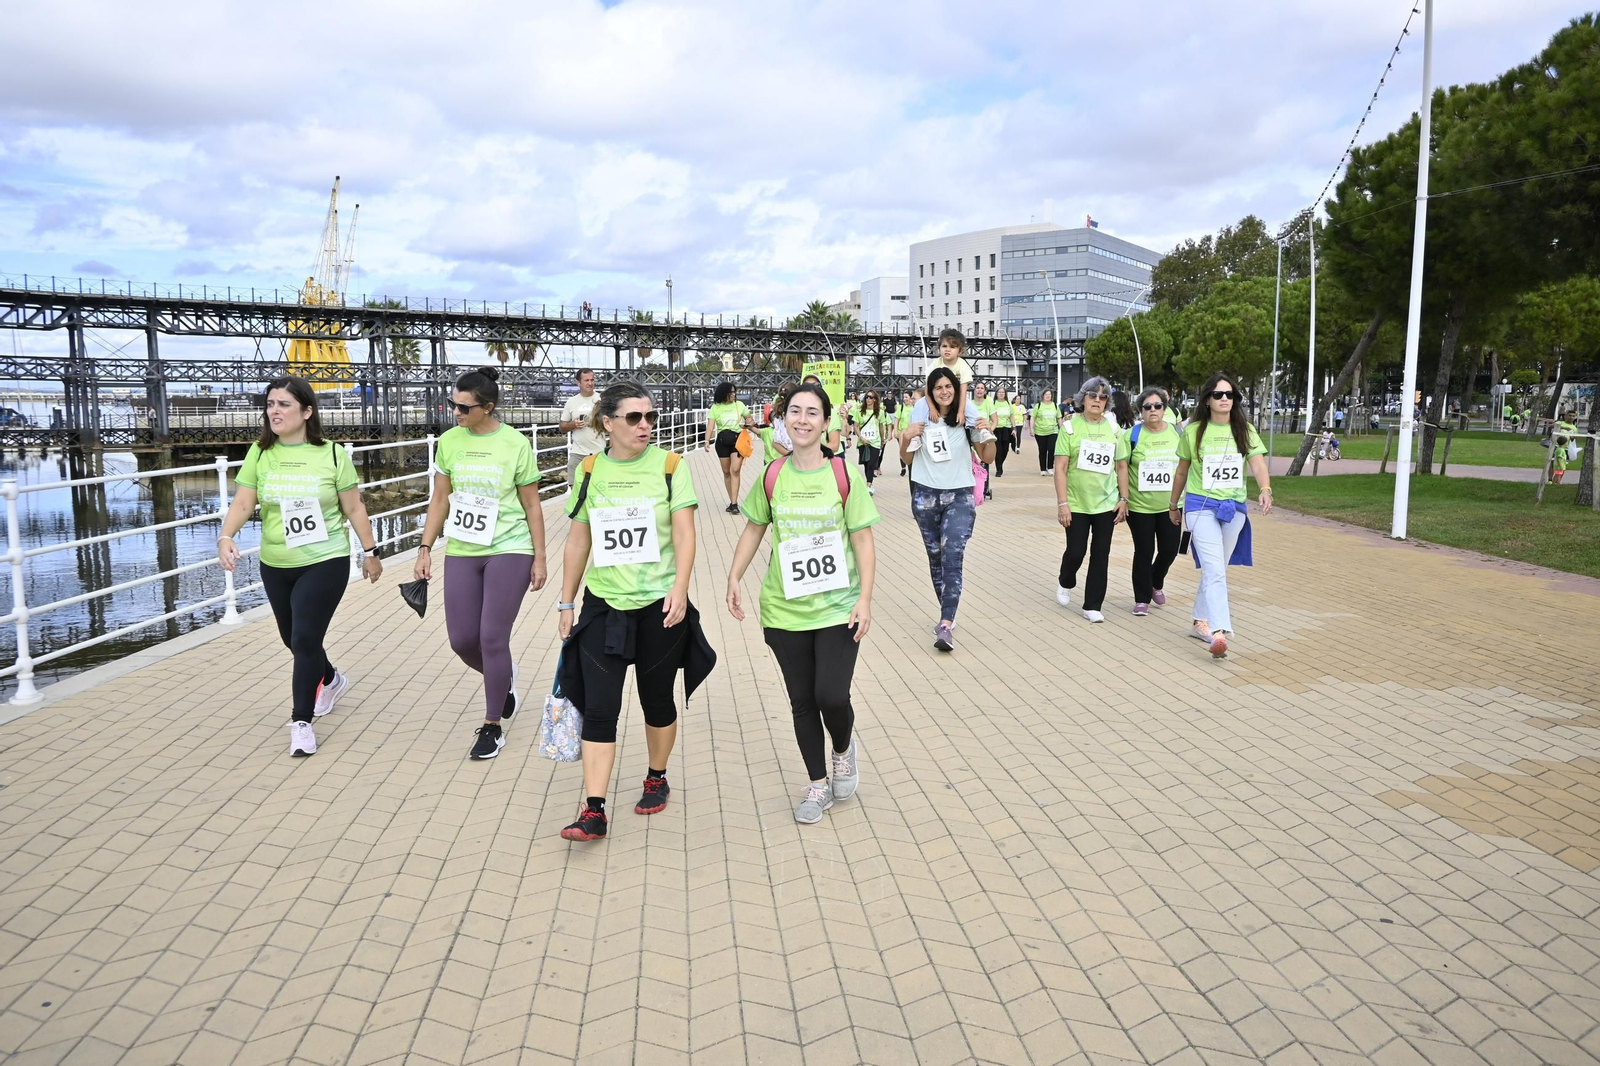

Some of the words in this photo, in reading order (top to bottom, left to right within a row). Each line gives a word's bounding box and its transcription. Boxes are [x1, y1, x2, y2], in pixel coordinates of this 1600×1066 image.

[454, 463, 464, 471] En
[467, 464, 503, 474] marcha
[267, 472, 279, 480] En
[282, 473, 321, 482] marcha
[454, 472, 489, 484] contra
[491, 476, 500, 486] el
[263, 482, 305, 493] contra
[307, 484, 320, 493] el
[612, 495, 657, 505] marcha
[777, 505, 789, 514] En
[793, 504, 837, 514] marcha
[454, 509, 487, 531] 505
[778, 517, 822, 528] contra
[824, 516, 837, 527] el
[604, 527, 648, 550] 507
[792, 555, 836, 582] 508
